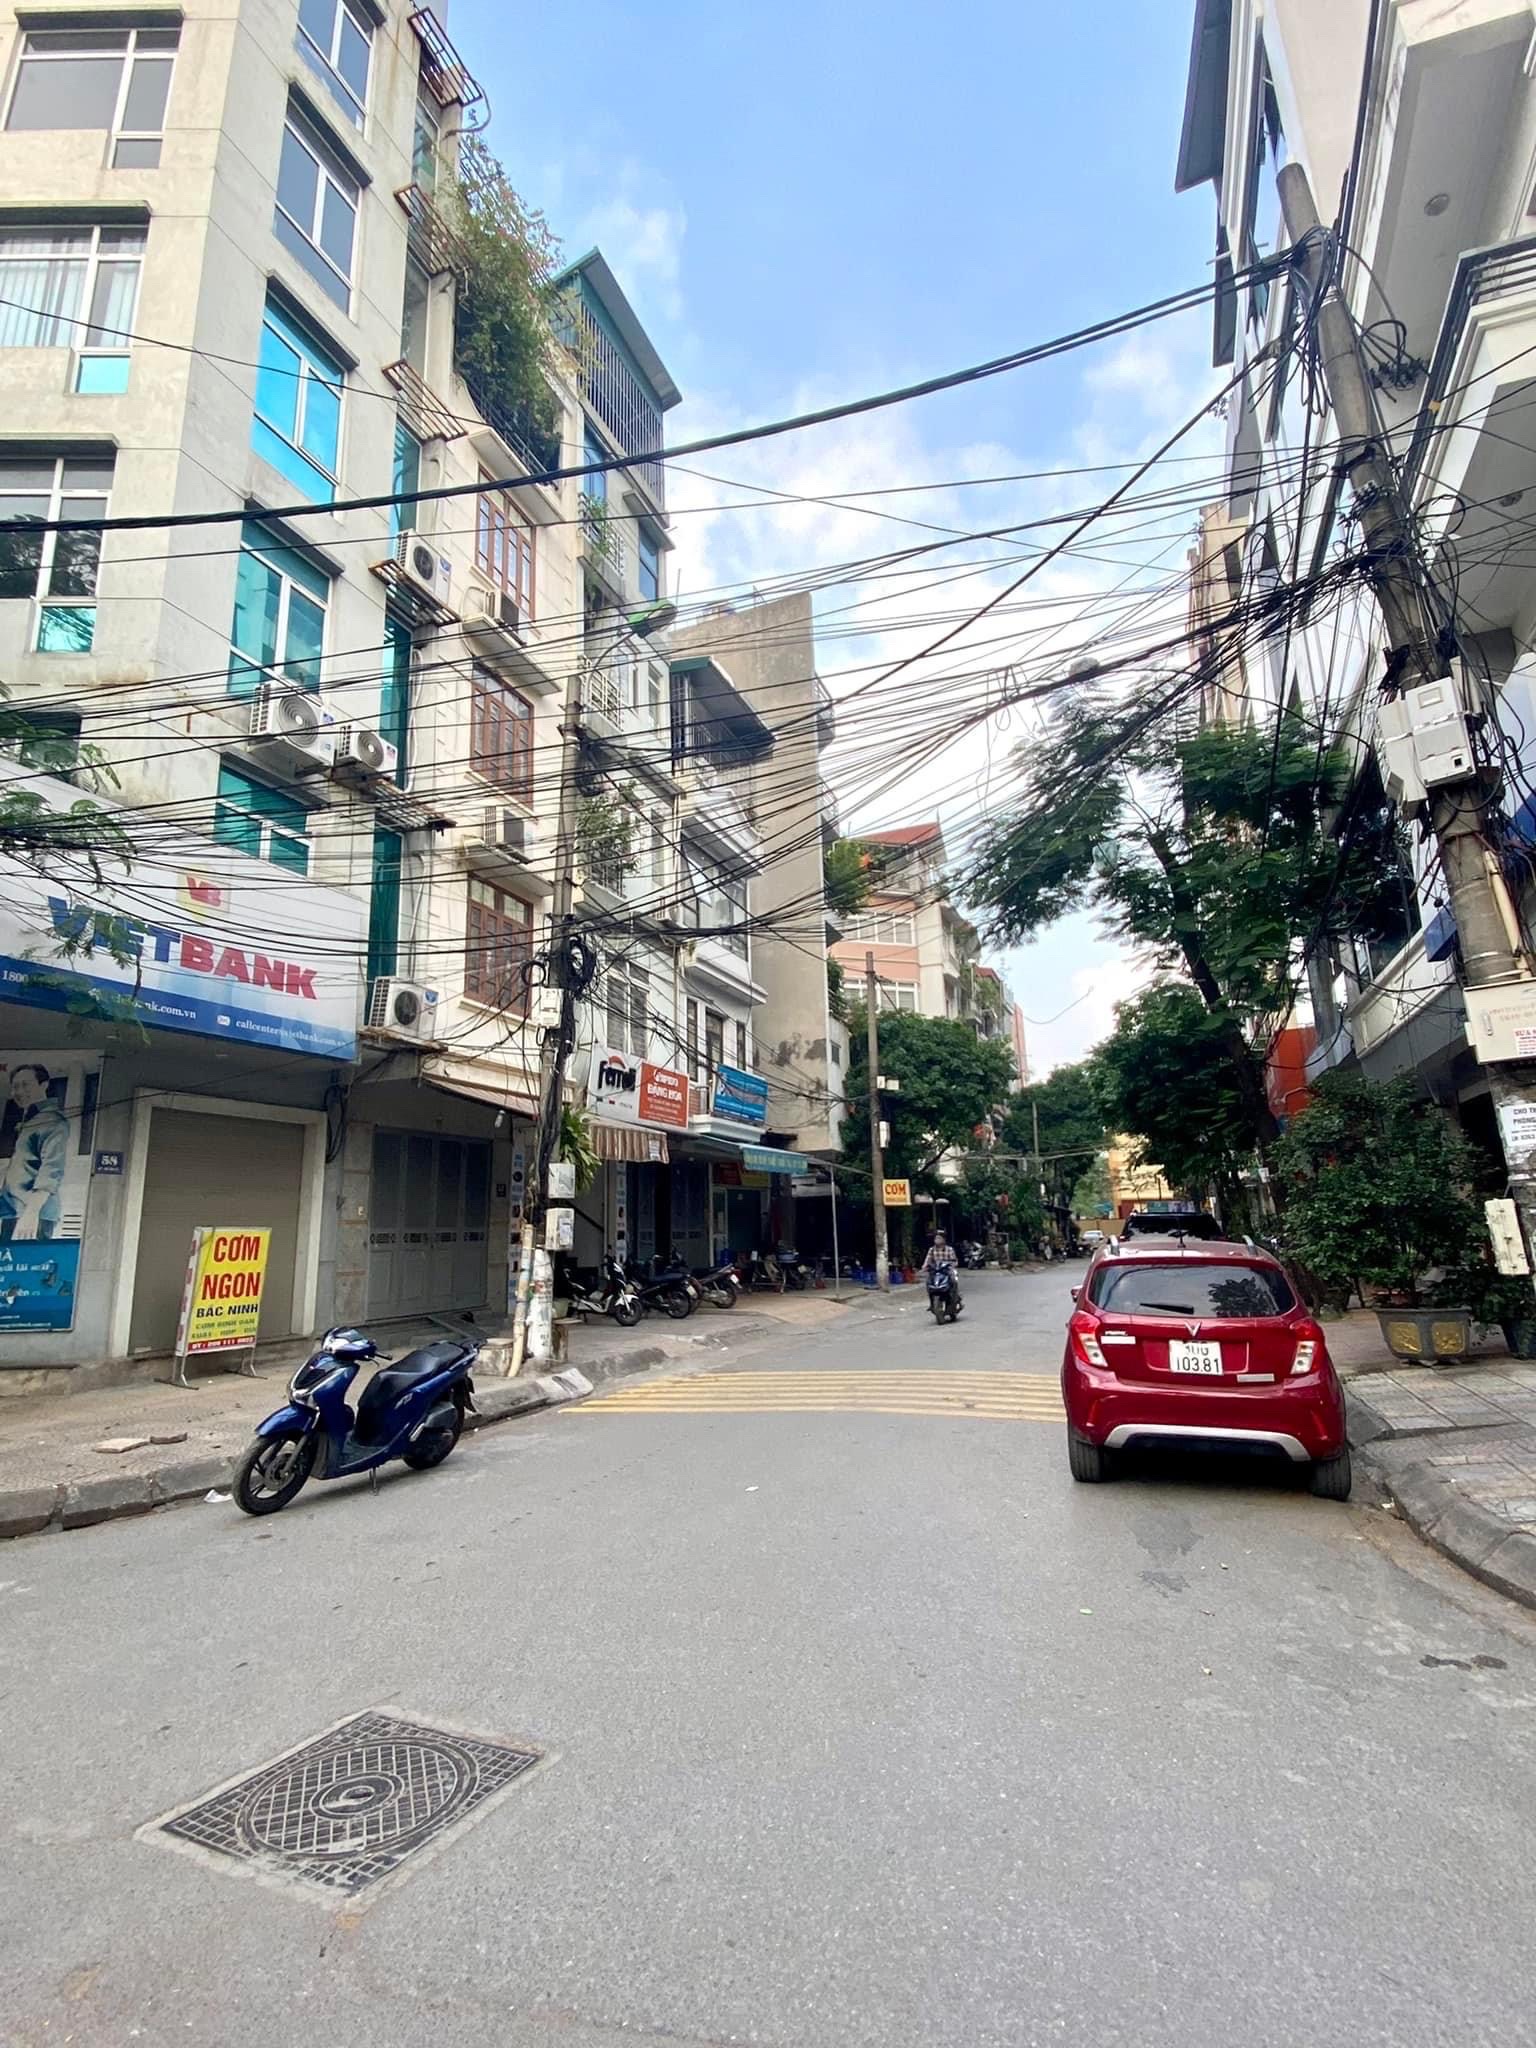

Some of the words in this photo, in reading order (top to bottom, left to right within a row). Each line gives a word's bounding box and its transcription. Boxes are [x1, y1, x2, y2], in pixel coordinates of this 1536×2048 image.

[214, 1235, 261, 1262] CƠM
[201, 1272, 261, 1300] NGON
[227, 1304, 259, 1315] NINH
[1177, 1357, 1219, 1373] 103.81
